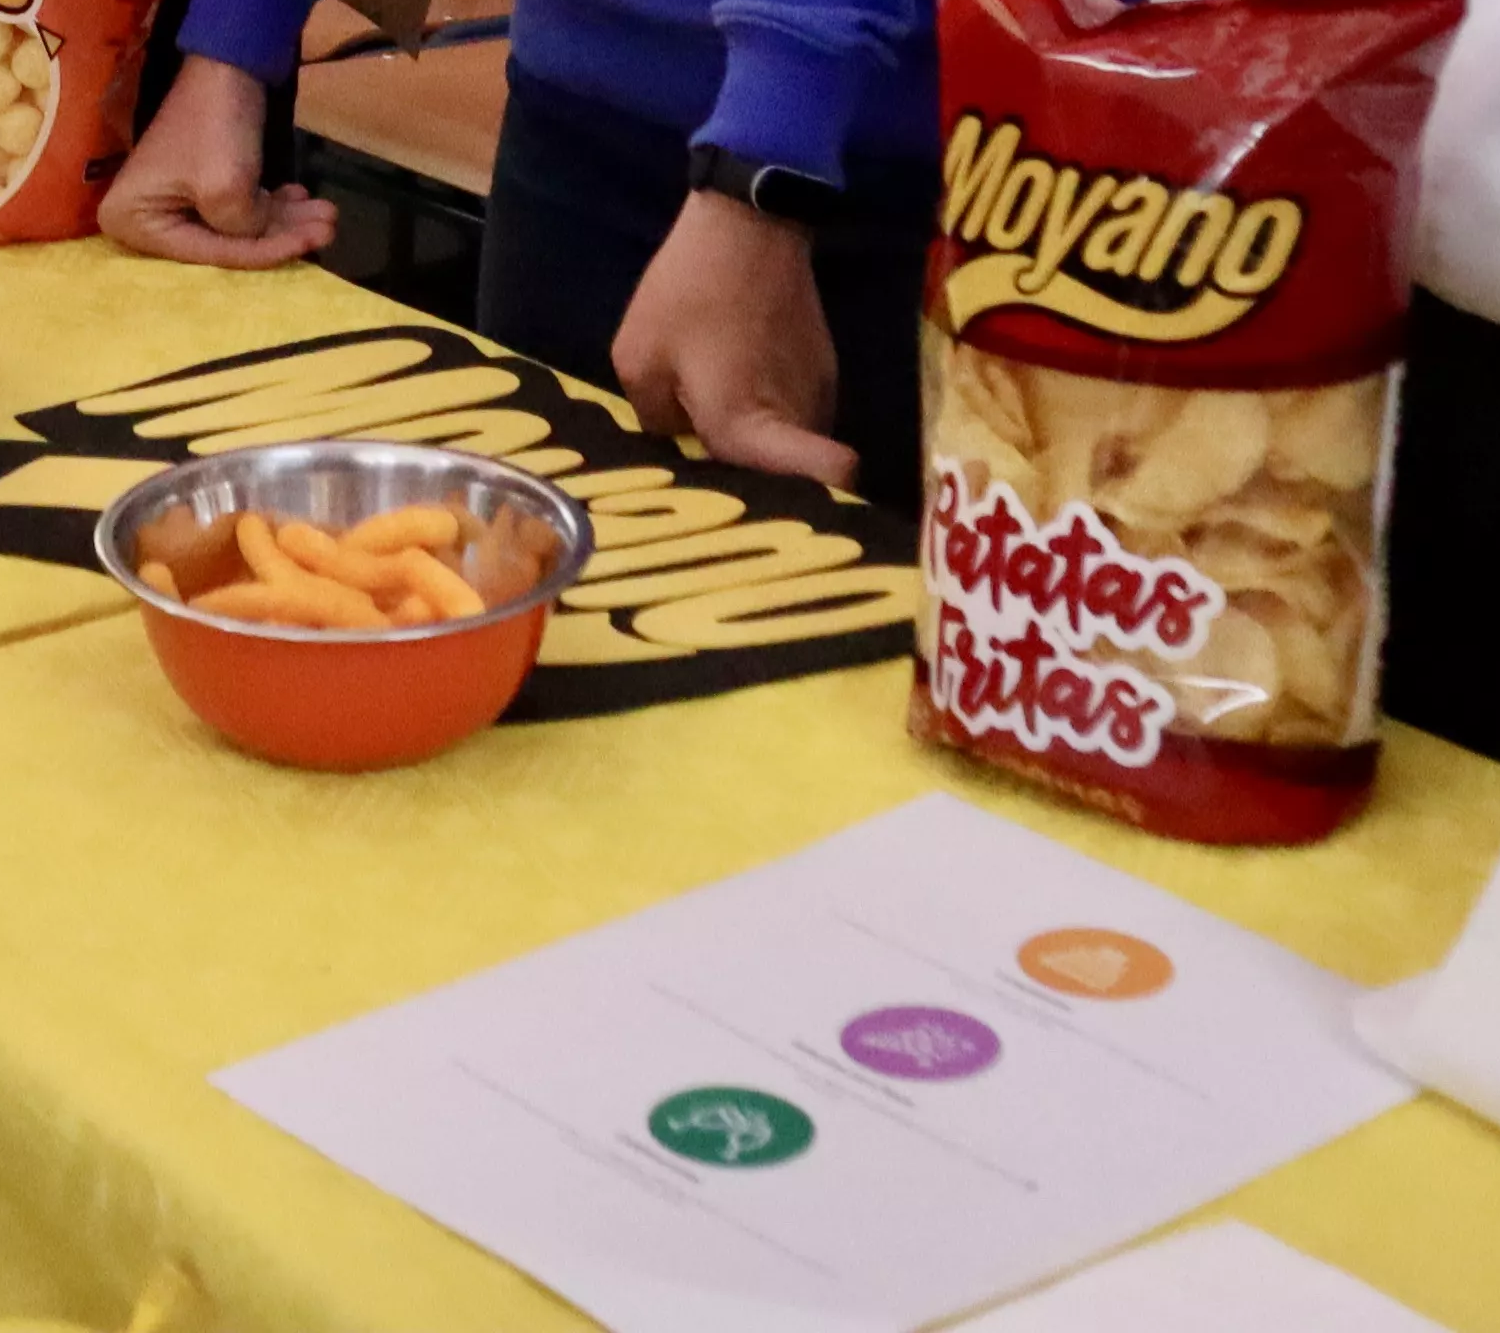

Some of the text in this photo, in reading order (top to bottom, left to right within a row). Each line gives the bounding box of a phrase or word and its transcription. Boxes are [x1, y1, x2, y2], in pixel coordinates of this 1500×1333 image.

[940, 113, 1305, 297] Moyano
[930, 470, 1209, 647] Patatas
[938, 599, 1160, 751] Fritas
